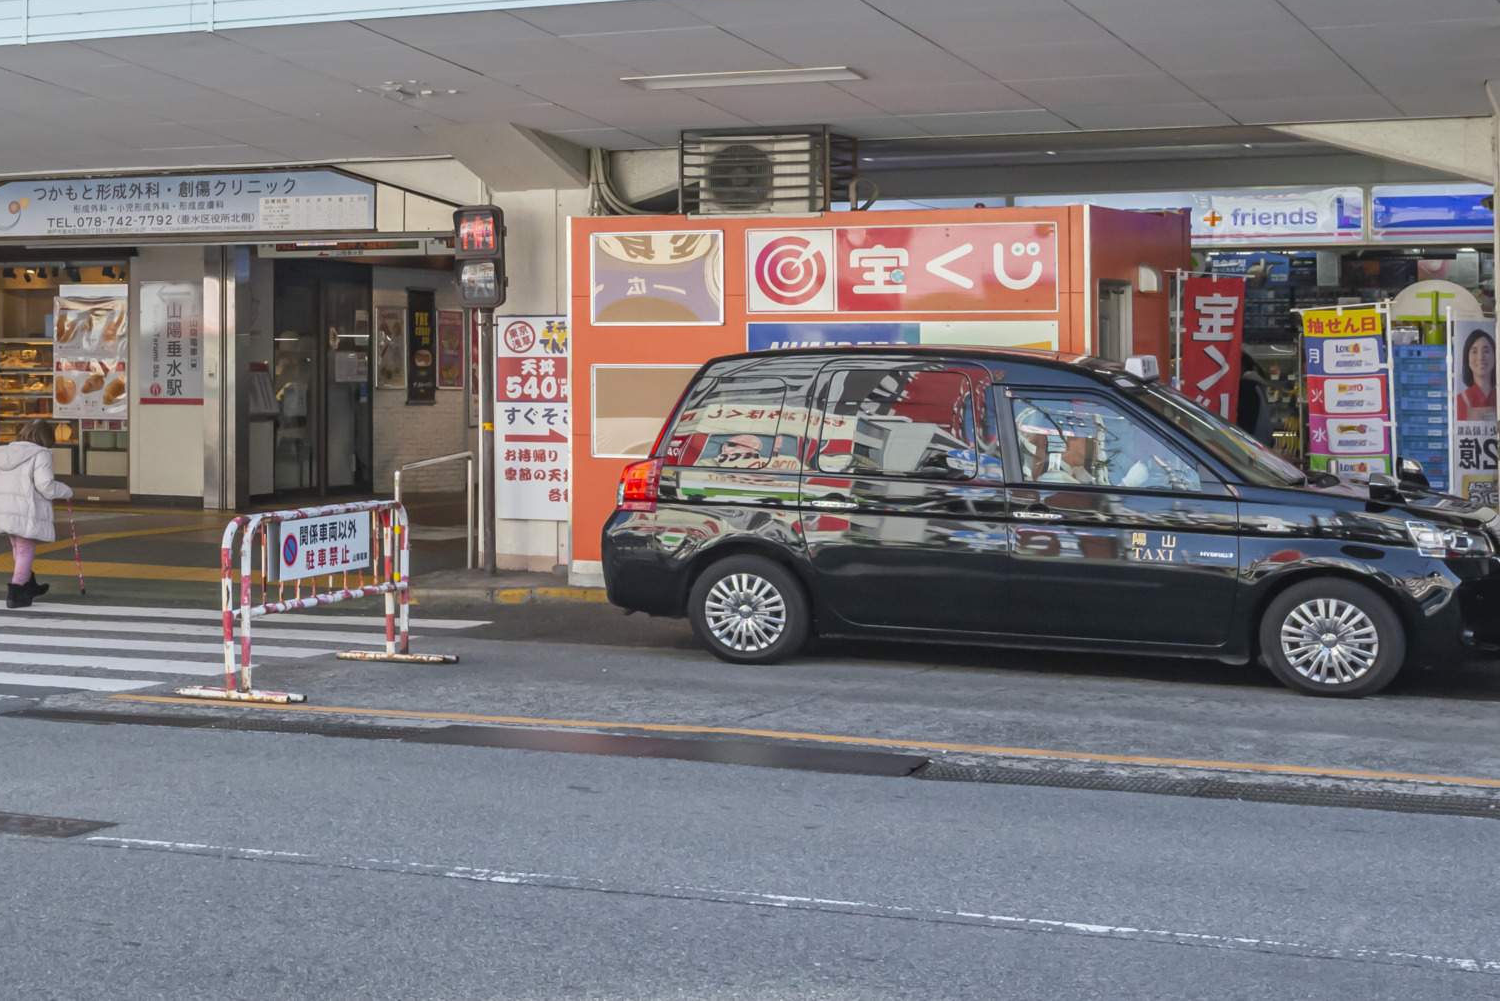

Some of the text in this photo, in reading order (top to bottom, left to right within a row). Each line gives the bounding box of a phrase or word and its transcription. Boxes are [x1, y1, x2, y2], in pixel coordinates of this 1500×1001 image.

[33, 177, 297, 201] つかもと形成外科・創傷クリニック
[73, 200, 224, 213] 形成外科・小児形成外科・形成皮膚科
[47, 214, 173, 228] TEL.078-742-7792
[1231, 207, 1318, 227] friends
[849, 242, 1043, 295] 宝くじ
[508, 325, 528, 339] 東京
[1307, 316, 1376, 335] 抽せん日
[189, 319, 198, 356] 山陽電車
[512, 336, 532, 350] 浅草
[166, 302, 182, 396] 山陽垂水駅
[1309, 348, 1320, 364] 月
[521, 358, 555, 375] 天丼
[1311, 387, 1323, 404] 火
[1312, 427, 1327, 443] 水
[504, 449, 558, 462] お持帰り
[300, 519, 357, 546] 関係車両以外
[306, 544, 350, 570] 駐車禁止
[1131, 547, 1174, 561] TAXI
